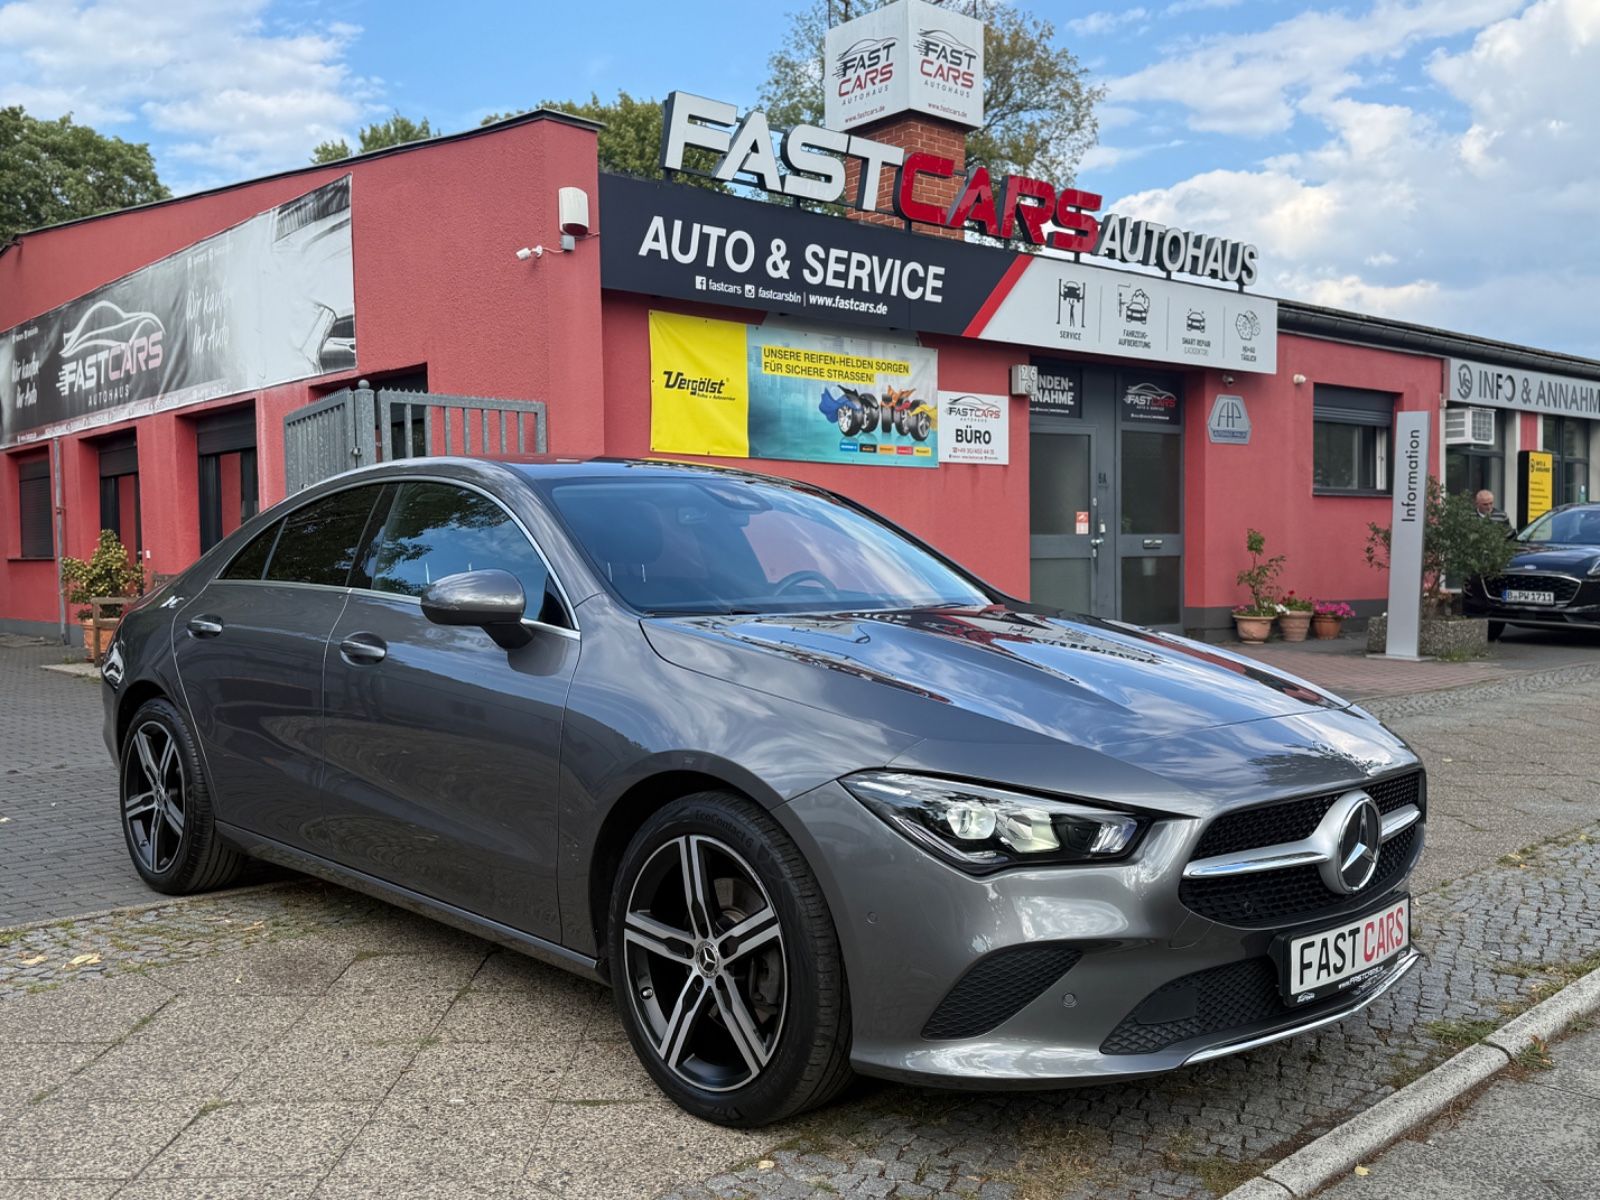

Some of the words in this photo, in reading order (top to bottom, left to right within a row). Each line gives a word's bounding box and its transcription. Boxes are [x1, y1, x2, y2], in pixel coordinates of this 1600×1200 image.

[841, 42, 896, 78] FAST
[923, 39, 976, 70] FAST
[838, 63, 894, 97] CARS
[920, 59, 975, 89] CARS
[842, 85, 889, 105] AUTOHAUS
[924, 80, 970, 98] AUTOHAUS
[845, 105, 885, 123] www.fastcars.de
[928, 102, 968, 118] www.fastcars.de
[638, 215, 755, 273] AUTO
[765, 238, 791, 280] &
[803, 244, 946, 303] SERVICE
[1095, 213, 1259, 286] AUTOHAUS
[708, 279, 742, 294] fastcars
[809, 293, 888, 315] www.fastcars.de
[1059, 330, 1081, 341] SERVICE
[763, 348, 801, 361] UNSERE
[803, 352, 874, 370] REIFEN-HELDEN
[875, 361, 909, 374] SORGEN
[763, 360, 783, 373] FÜR
[785, 364, 825, 378] SICHERE
[827, 369, 874, 383] STRASSEN!
[663, 370, 725, 395] Vergölst
[1037, 374, 1074, 390] NDEN-
[1479, 370, 1516, 402] INFO
[1521, 377, 1532, 405] &
[1536, 379, 1600, 414] ANNAHM
[88, 384, 130, 407] AUTOHAUS
[1030, 389, 1075, 405] NAHME
[955, 424, 992, 444] BÜRO
[1401, 429, 1420, 522] Information
[695, 809, 746, 841] EcoContact
